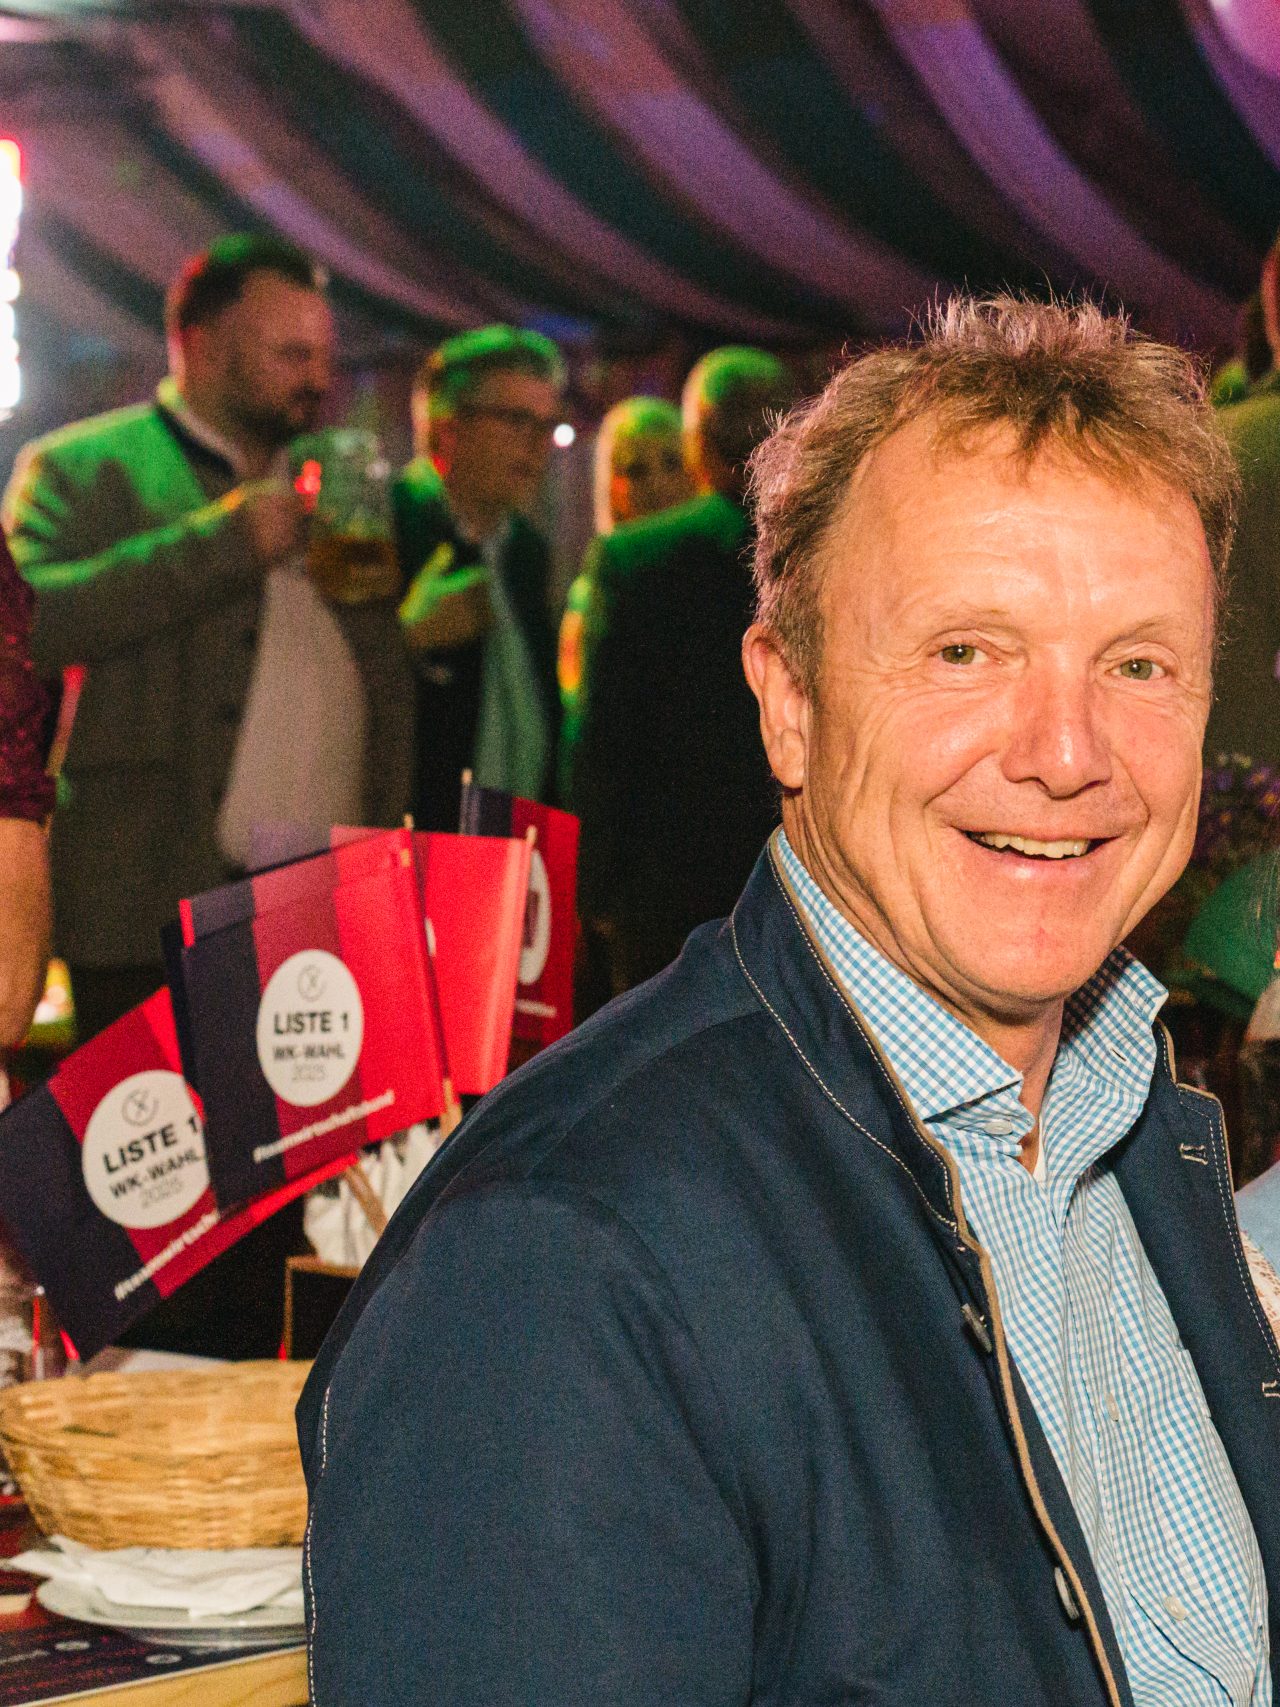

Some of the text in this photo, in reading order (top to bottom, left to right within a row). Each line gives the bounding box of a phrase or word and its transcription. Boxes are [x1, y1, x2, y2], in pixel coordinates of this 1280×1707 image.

[274, 1011, 349, 1034] LISTE 1
[103, 1115, 199, 1174] LISTE 1
